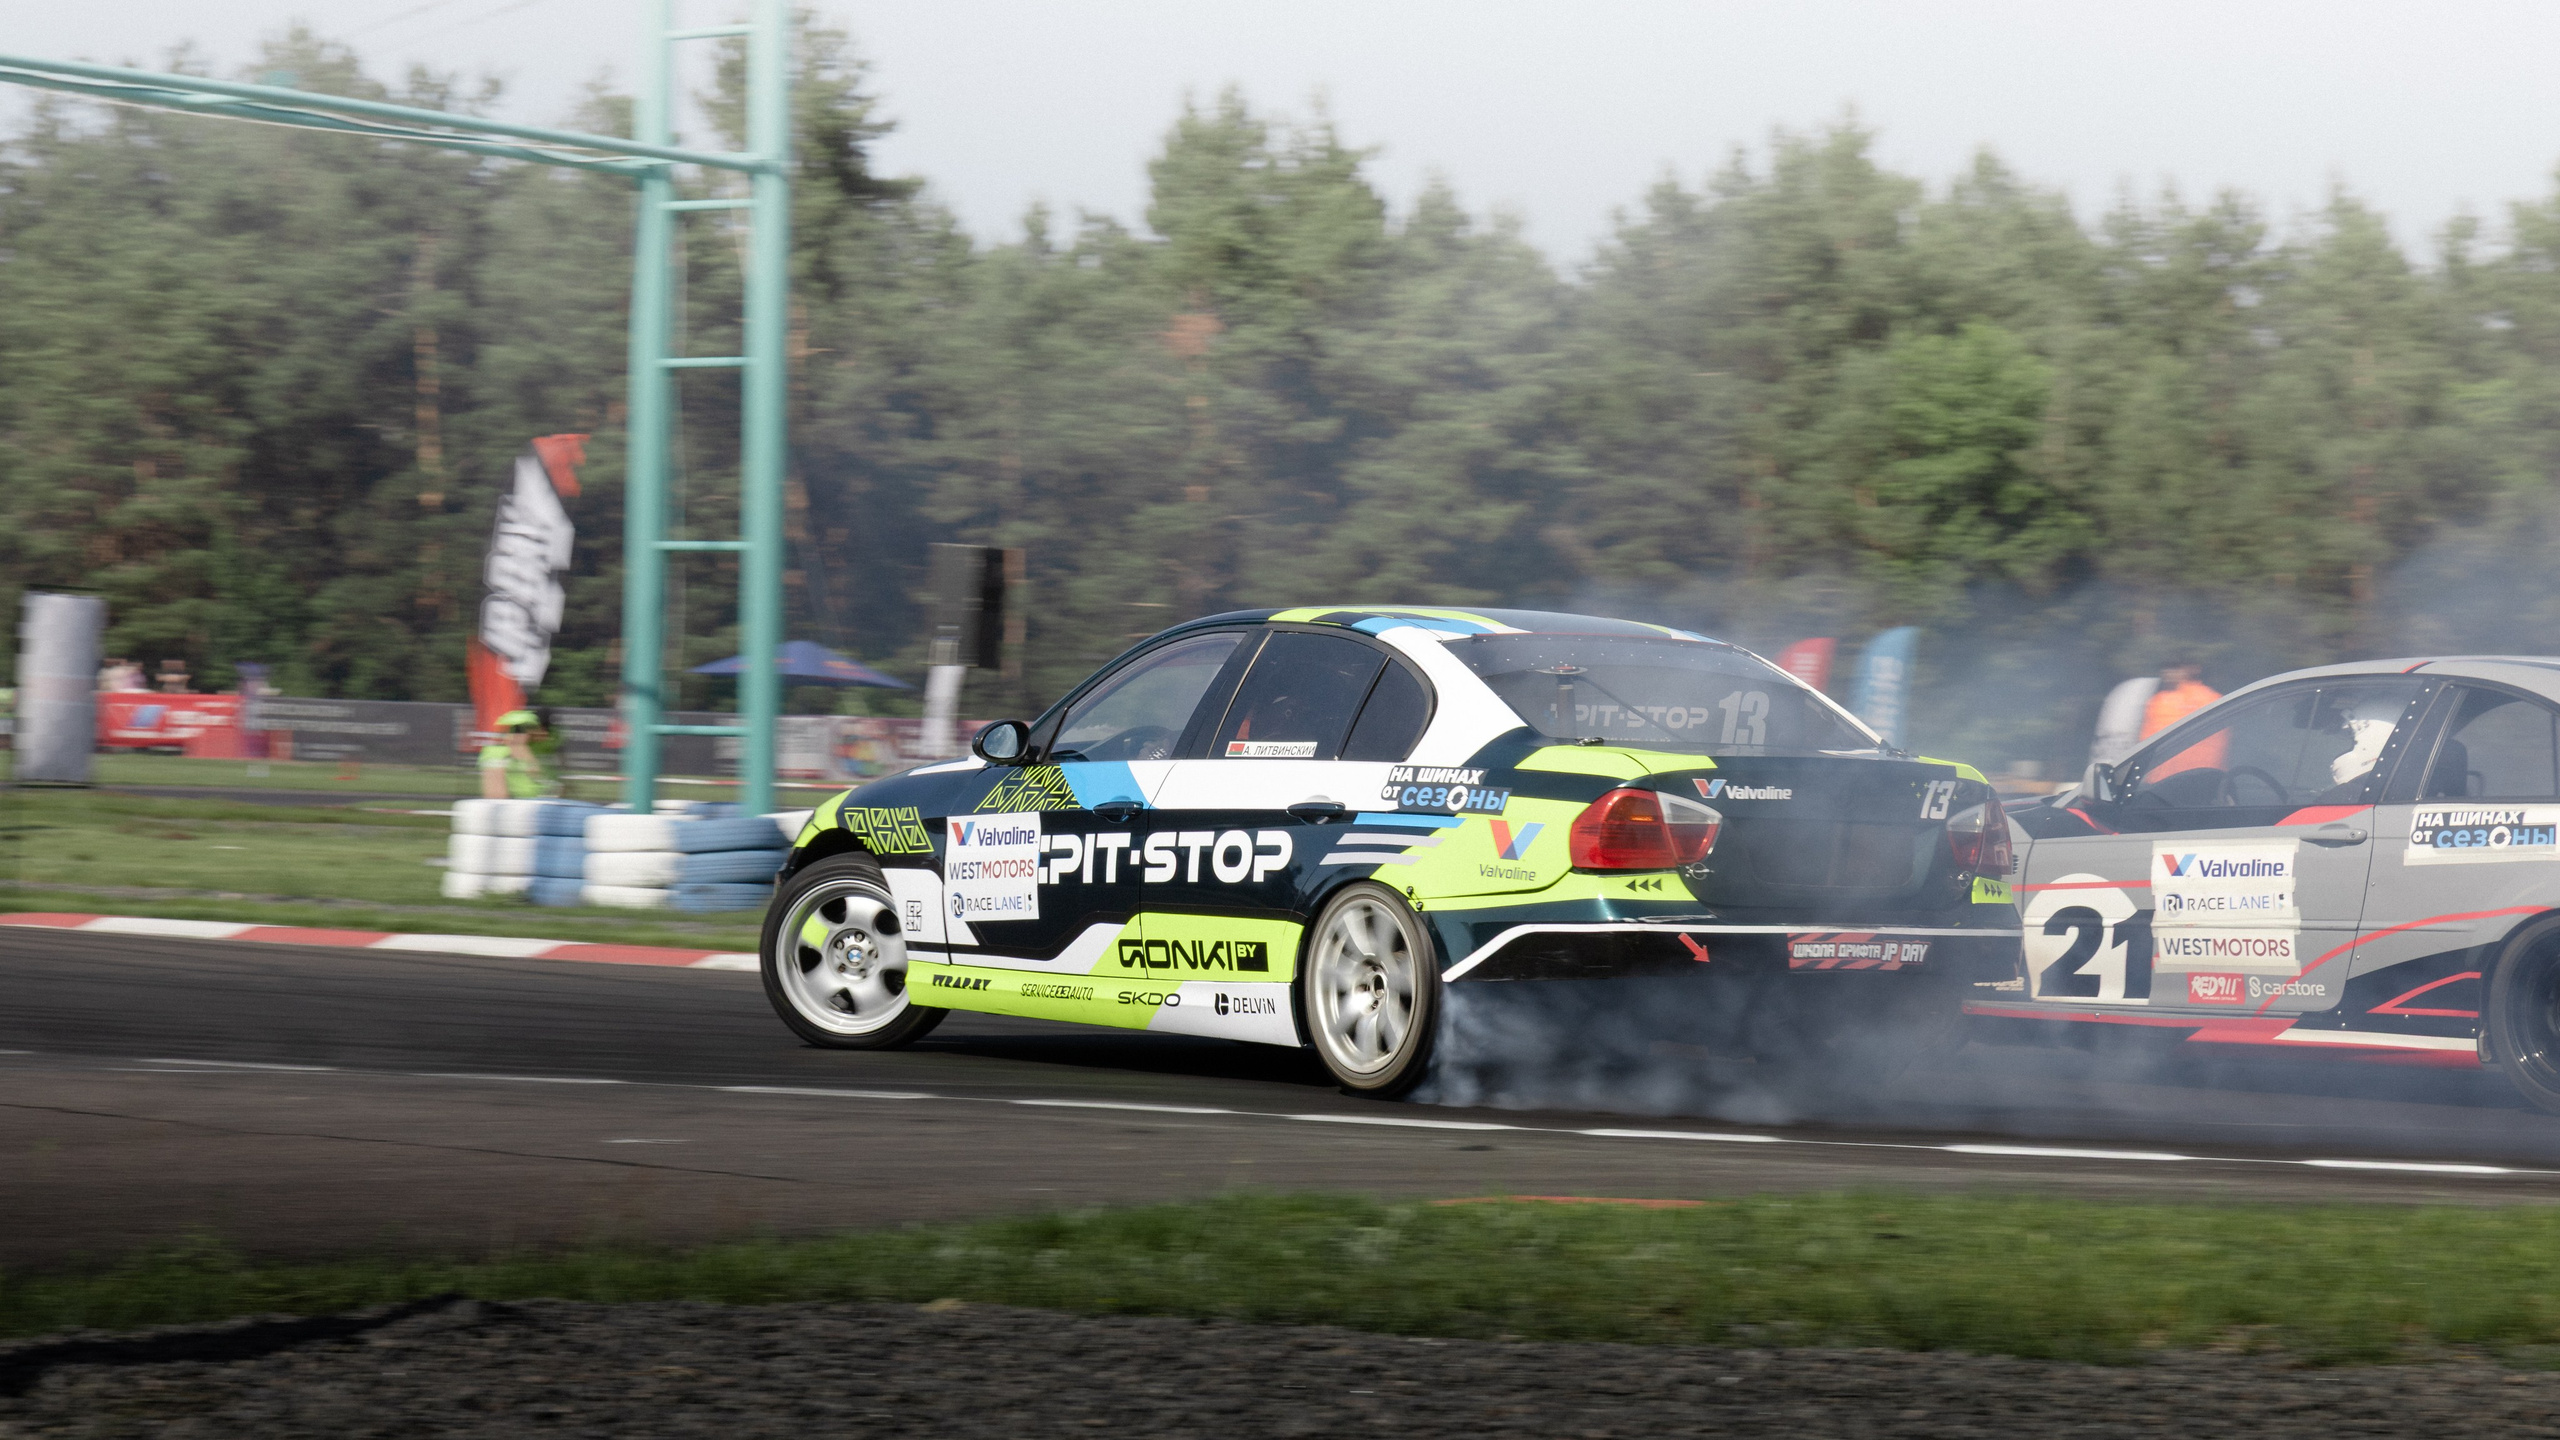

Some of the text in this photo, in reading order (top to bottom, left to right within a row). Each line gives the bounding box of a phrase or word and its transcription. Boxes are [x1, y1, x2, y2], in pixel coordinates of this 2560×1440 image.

[1390, 767, 1484, 785] НА ШИНАХ
[1725, 785, 1792, 800] Valvoline
[1920, 780, 1956, 819] 13
[2418, 811, 2522, 827] НА ШИНАХ
[977, 826, 1035, 846] Valvoline
[949, 859, 1034, 880] WESTMOTORS
[1479, 864, 1536, 881] Valvoline
[2199, 859, 2284, 877] Valvoline
[967, 897, 992, 911] RACE
[994, 896, 1022, 910] LANE
[2188, 897, 2225, 911] RACE
[2229, 895, 2270, 910] LANE
[1118, 939, 1256, 971] GONKI BY
[1882, 943, 1899, 961] JP
[1900, 944, 1928, 962] DAY
[2037, 905, 2155, 999] 21
[2163, 938, 2290, 957] WESTMOTORS
[2263, 981, 2325, 996] carstore
[1117, 991, 1181, 1007] SKDO
